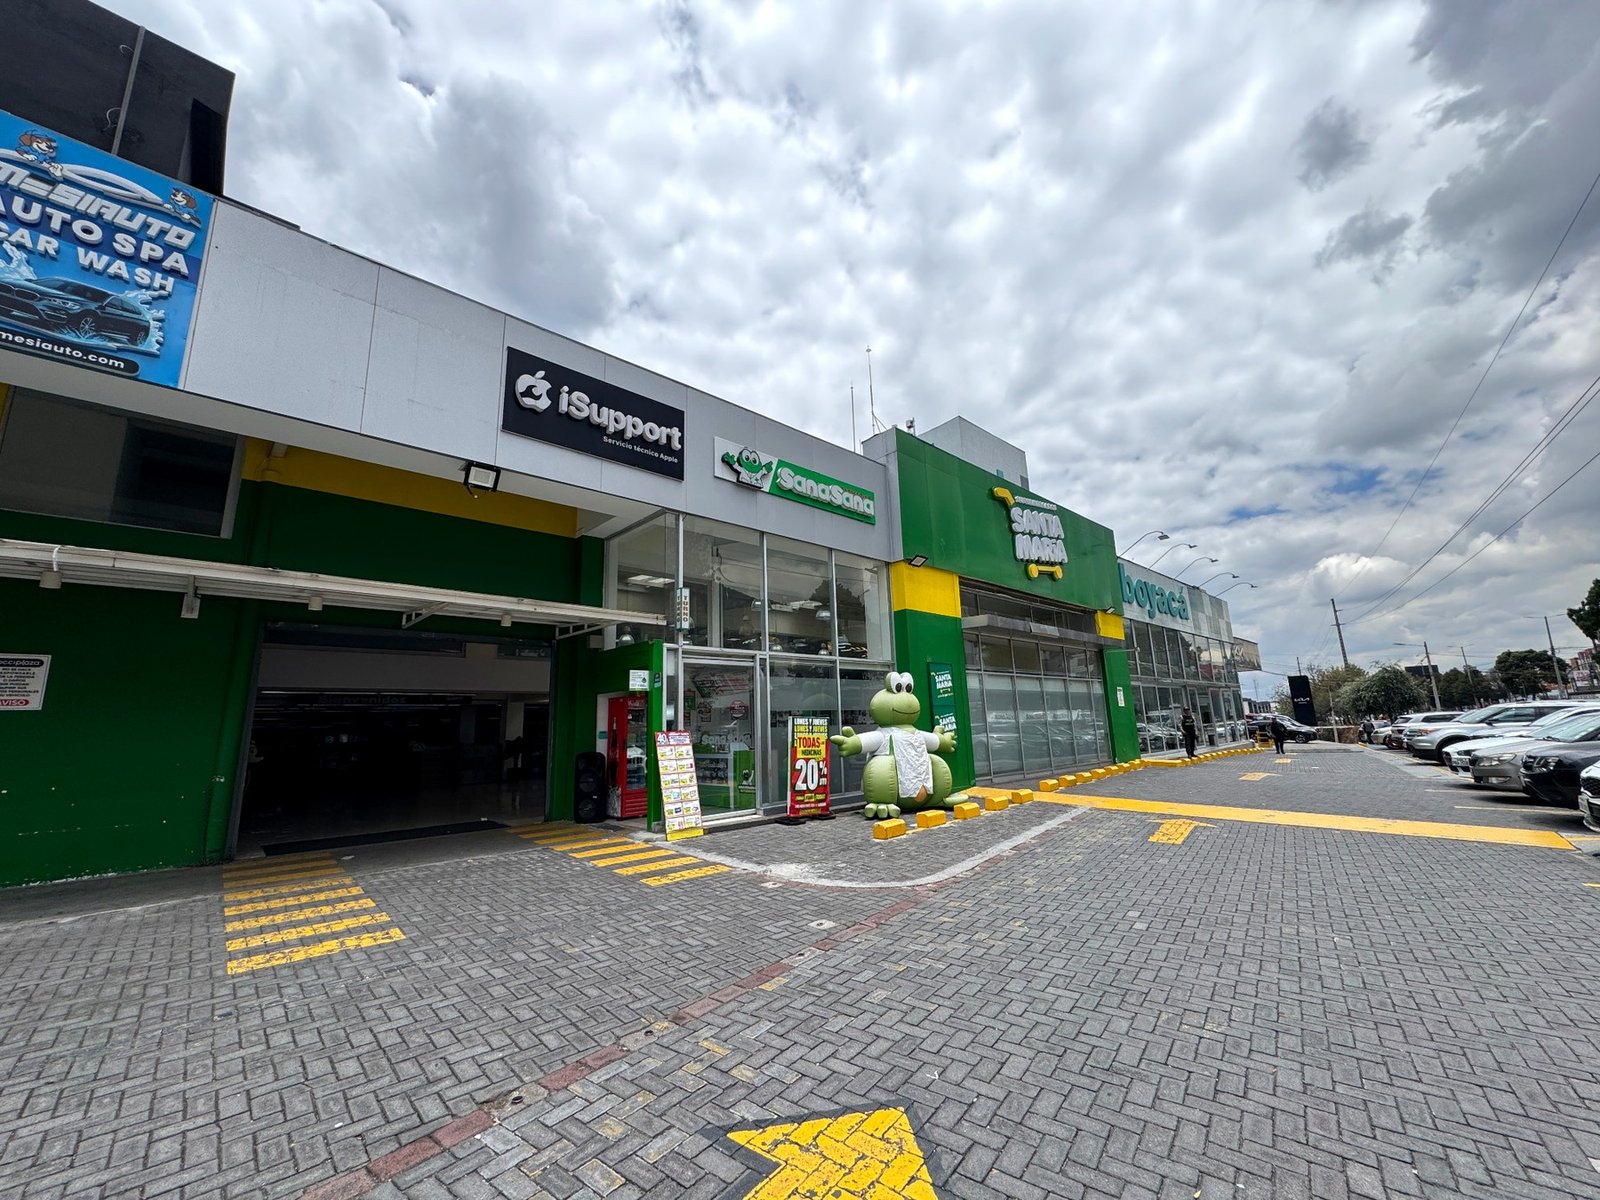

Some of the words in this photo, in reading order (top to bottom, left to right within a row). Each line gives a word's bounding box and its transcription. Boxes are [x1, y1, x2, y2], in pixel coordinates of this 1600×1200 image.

[0, 195, 103, 245] UTO
[112, 232, 189, 276] SPA
[76, 246, 175, 293] WASH
[558, 385, 682, 451] iSupport
[602, 435, 633, 450] Servicio
[633, 445, 659, 458] técnico
[659, 453, 679, 464] Apple
[776, 467, 875, 516] SanaSana
[1011, 507, 1064, 539] SANTA
[1117, 563, 1189, 620] boyacá
[798, 737, 821, 748] TODAS
